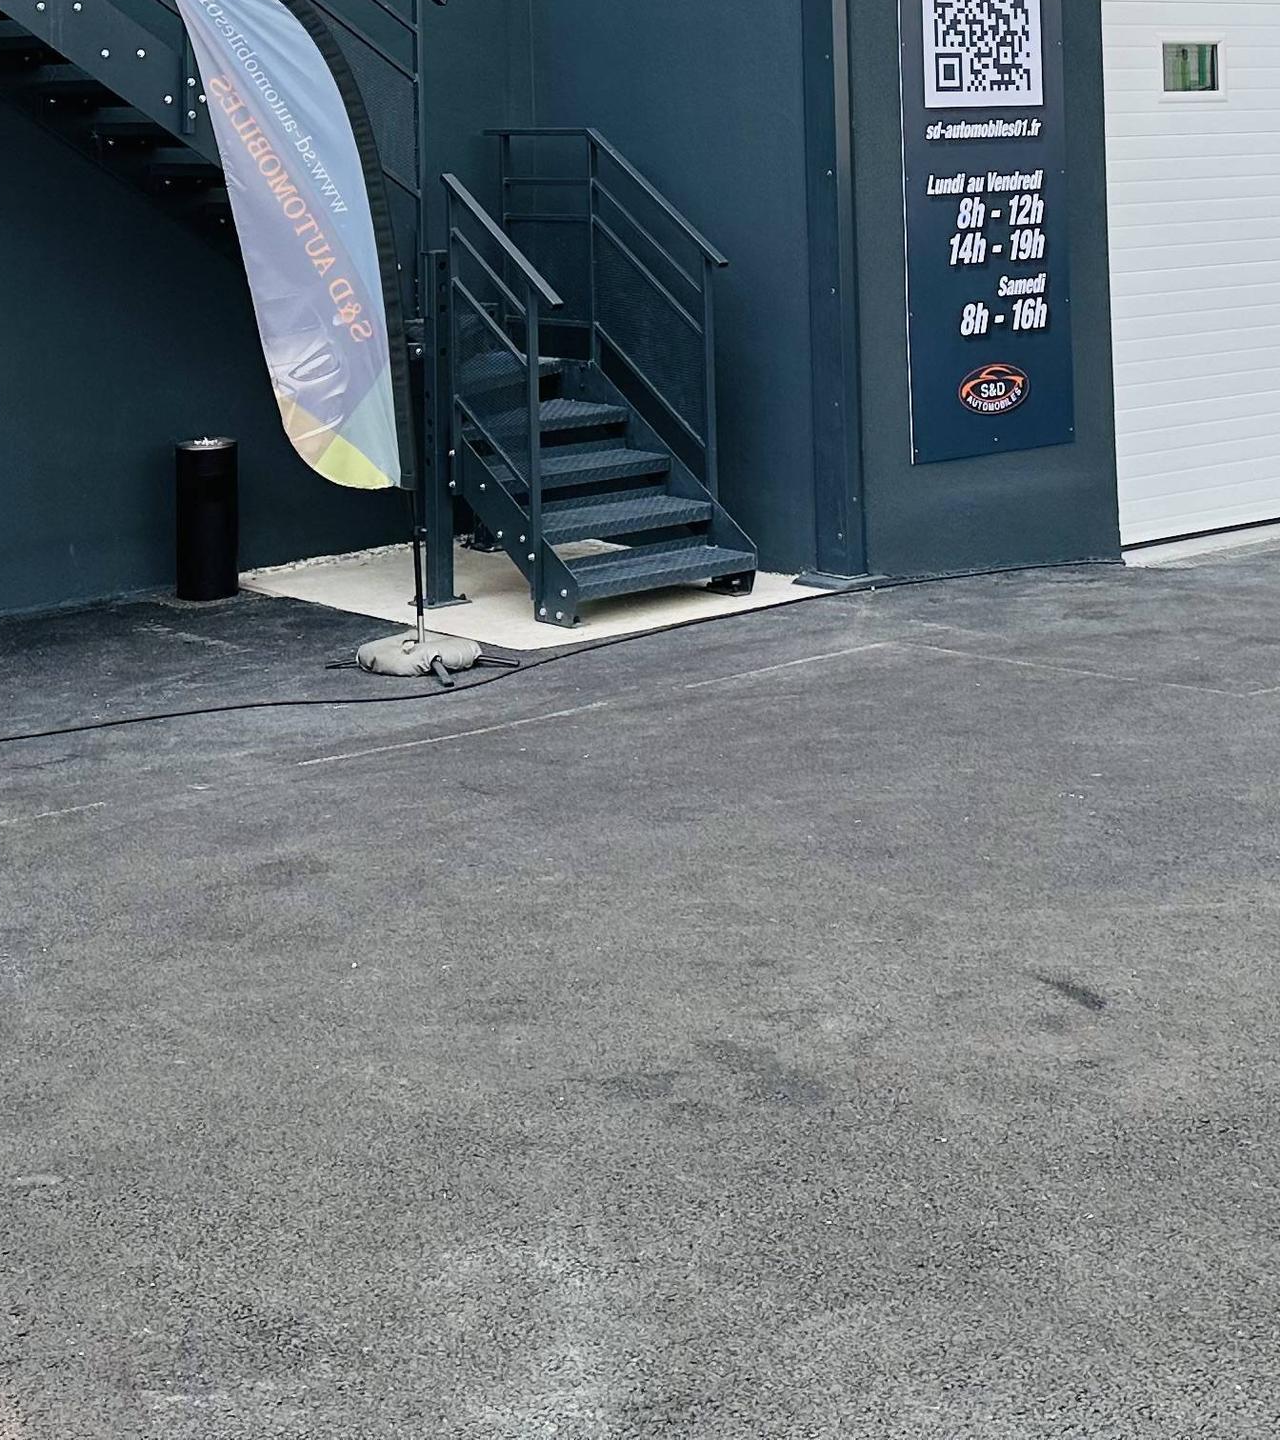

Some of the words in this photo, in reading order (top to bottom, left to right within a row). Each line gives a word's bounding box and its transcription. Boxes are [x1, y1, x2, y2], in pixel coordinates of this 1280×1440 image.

[925, 118, 1042, 140] sd-automobiles01.fr
[926, 172, 966, 195] Lundi
[966, 176, 985, 194] au
[987, 169, 1044, 192] Vendredi
[956, 196, 986, 230] 8h
[1008, 193, 1045, 226] 12h
[949, 231, 987, 266] 14h
[1010, 227, 1046, 261] 19h
[997, 272, 1047, 297] Samedi
[960, 302, 989, 336] 8h
[1012, 296, 1048, 331] 16h
[966, 387, 1022, 411] AUTOMOBILES
[980, 382, 1006, 398] S&D
